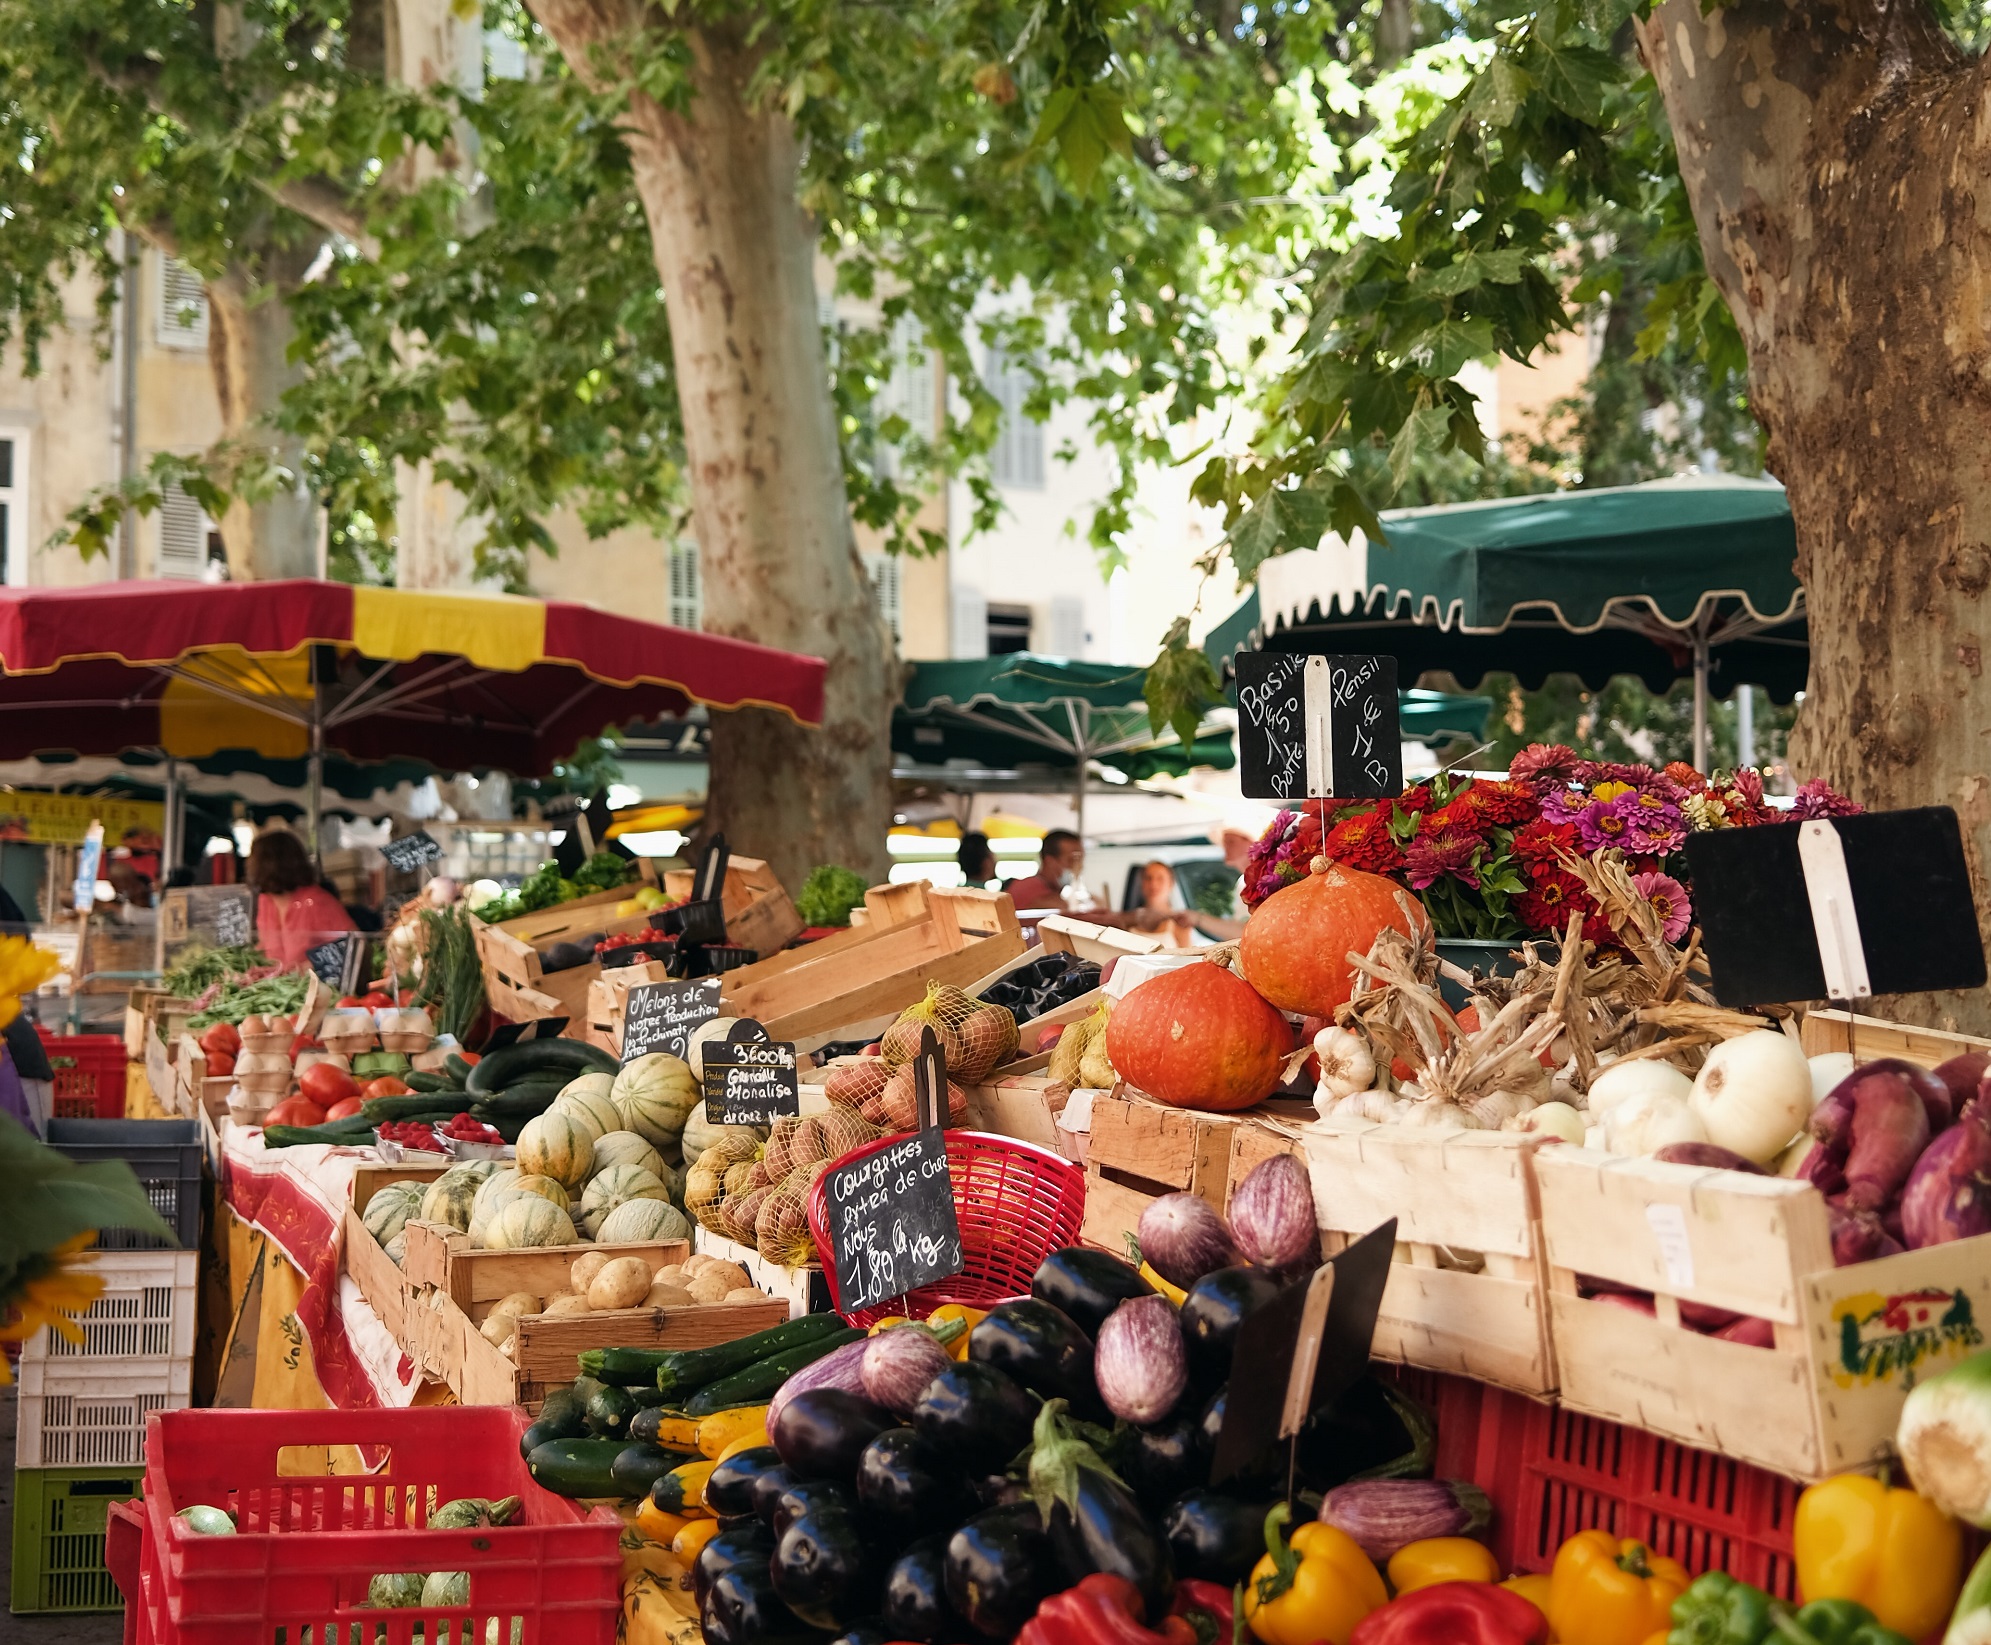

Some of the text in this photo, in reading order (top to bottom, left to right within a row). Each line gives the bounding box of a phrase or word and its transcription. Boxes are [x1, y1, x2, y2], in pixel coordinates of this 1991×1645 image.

[630, 986, 705, 1019] Melons de
[834, 1140, 923, 1202] Courgettes
[895, 1170, 918, 1195] de
